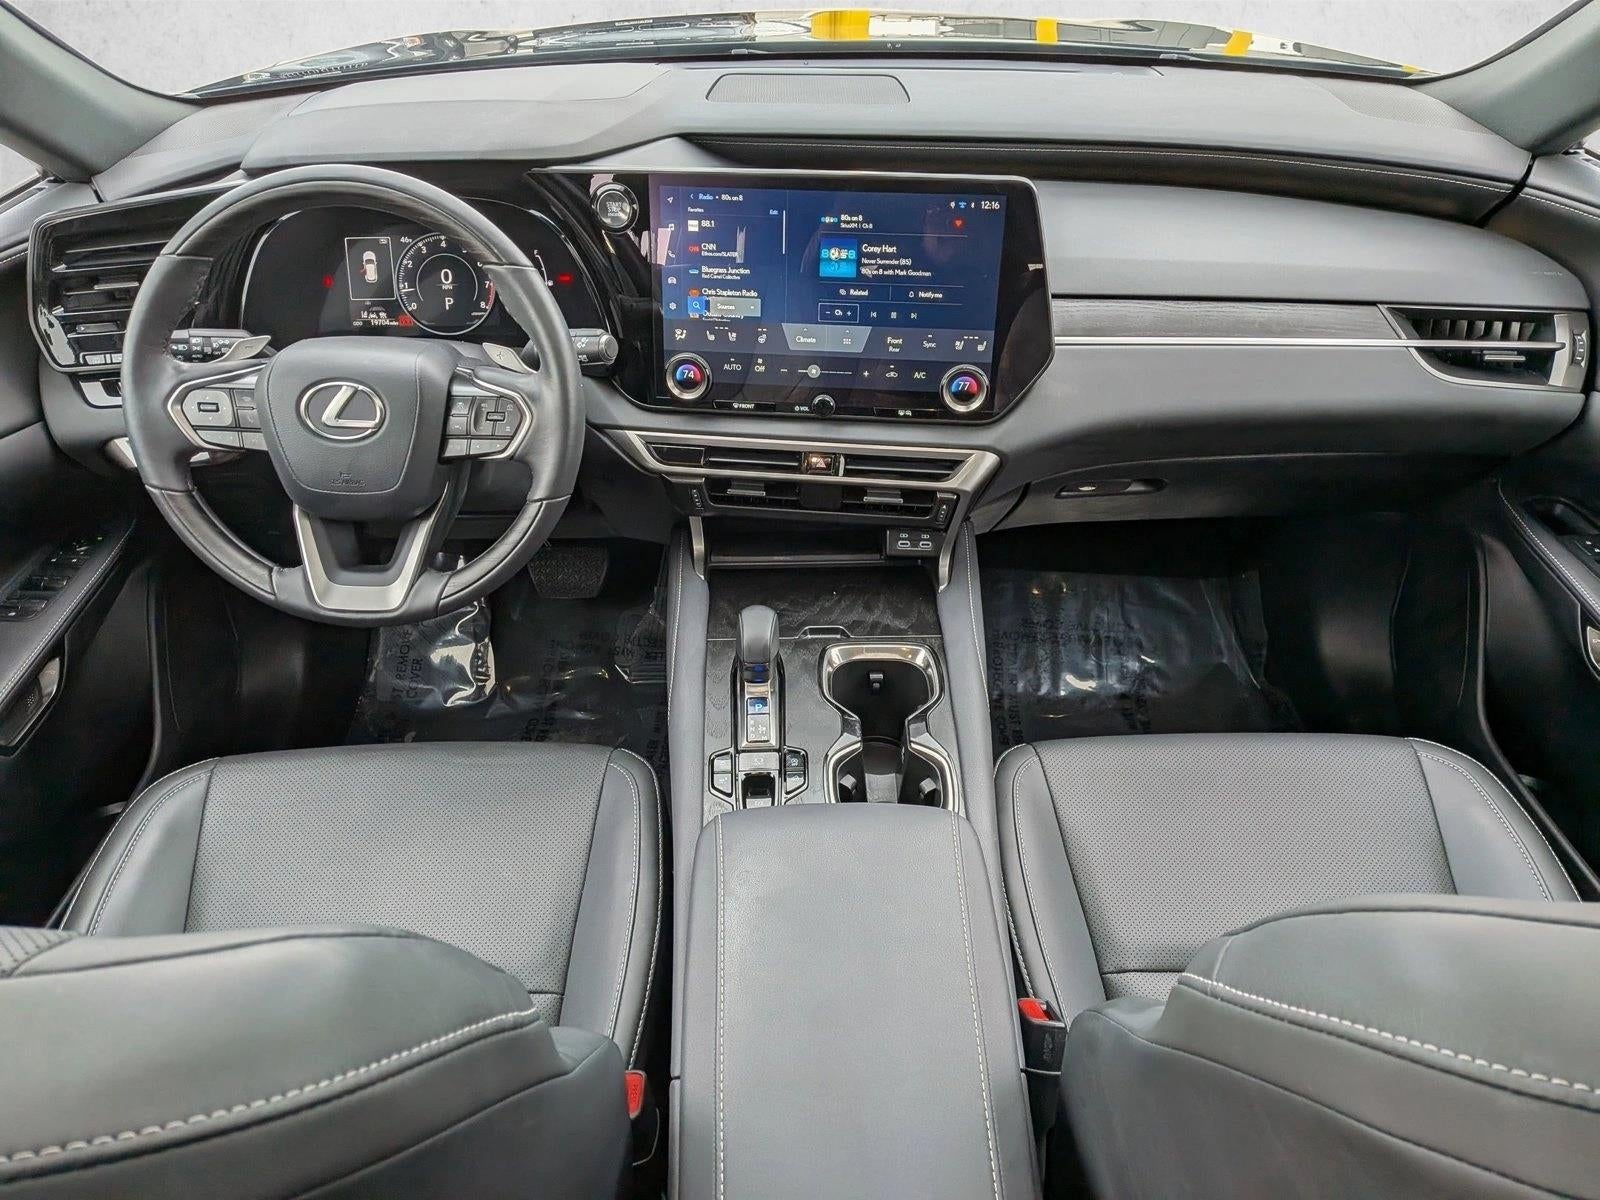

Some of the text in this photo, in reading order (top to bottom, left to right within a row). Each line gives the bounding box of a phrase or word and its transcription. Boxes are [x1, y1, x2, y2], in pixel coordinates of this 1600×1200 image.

[981, 201, 1000, 210] 12:16
[862, 244, 897, 254] Corey Hart
[440, 268, 452, 284] 0
[445, 298, 454, 310] P
[887, 337, 902, 345] Front
[683, 370, 694, 379] 74
[958, 381, 970, 390] 77
